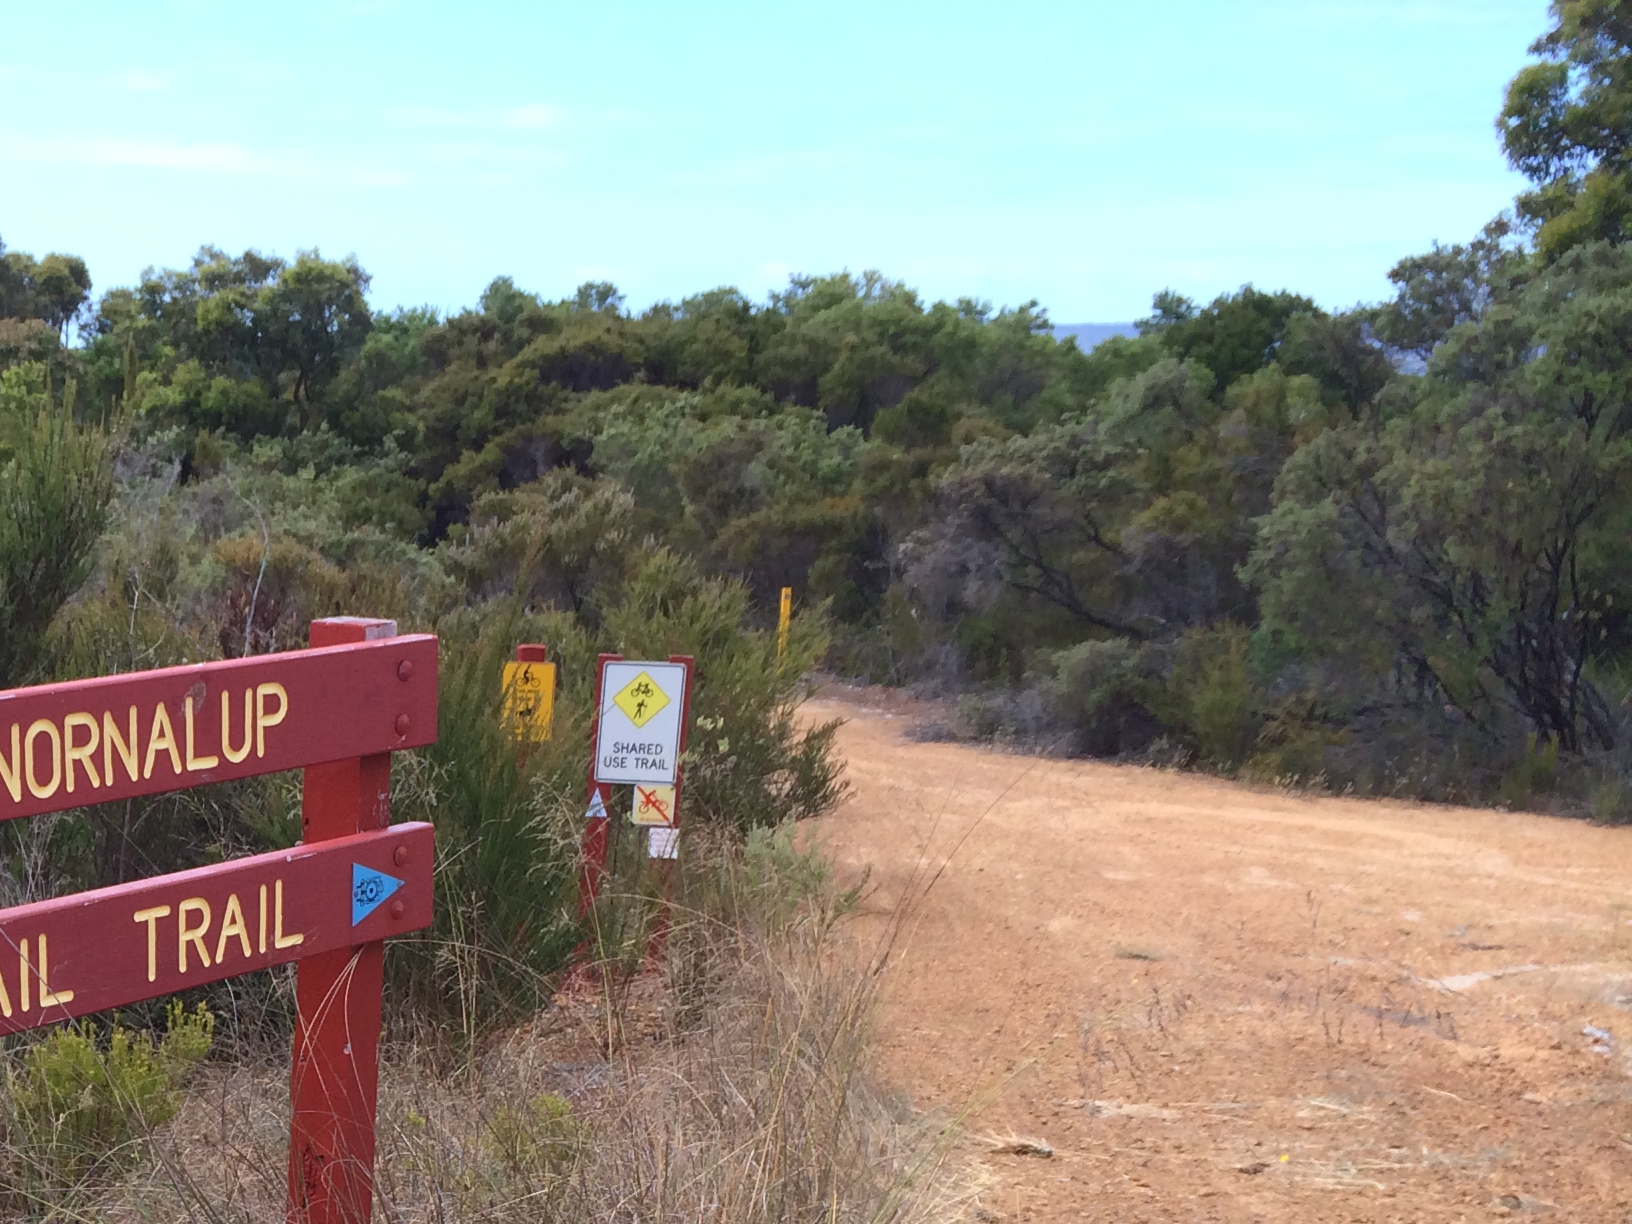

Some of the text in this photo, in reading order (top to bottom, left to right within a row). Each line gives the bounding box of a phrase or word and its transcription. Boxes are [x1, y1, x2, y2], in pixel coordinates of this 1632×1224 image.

[612, 742, 663, 755] SHARED
[603, 756, 669, 770] USE TRAIL
[134, 879, 305, 983] TRAIL
